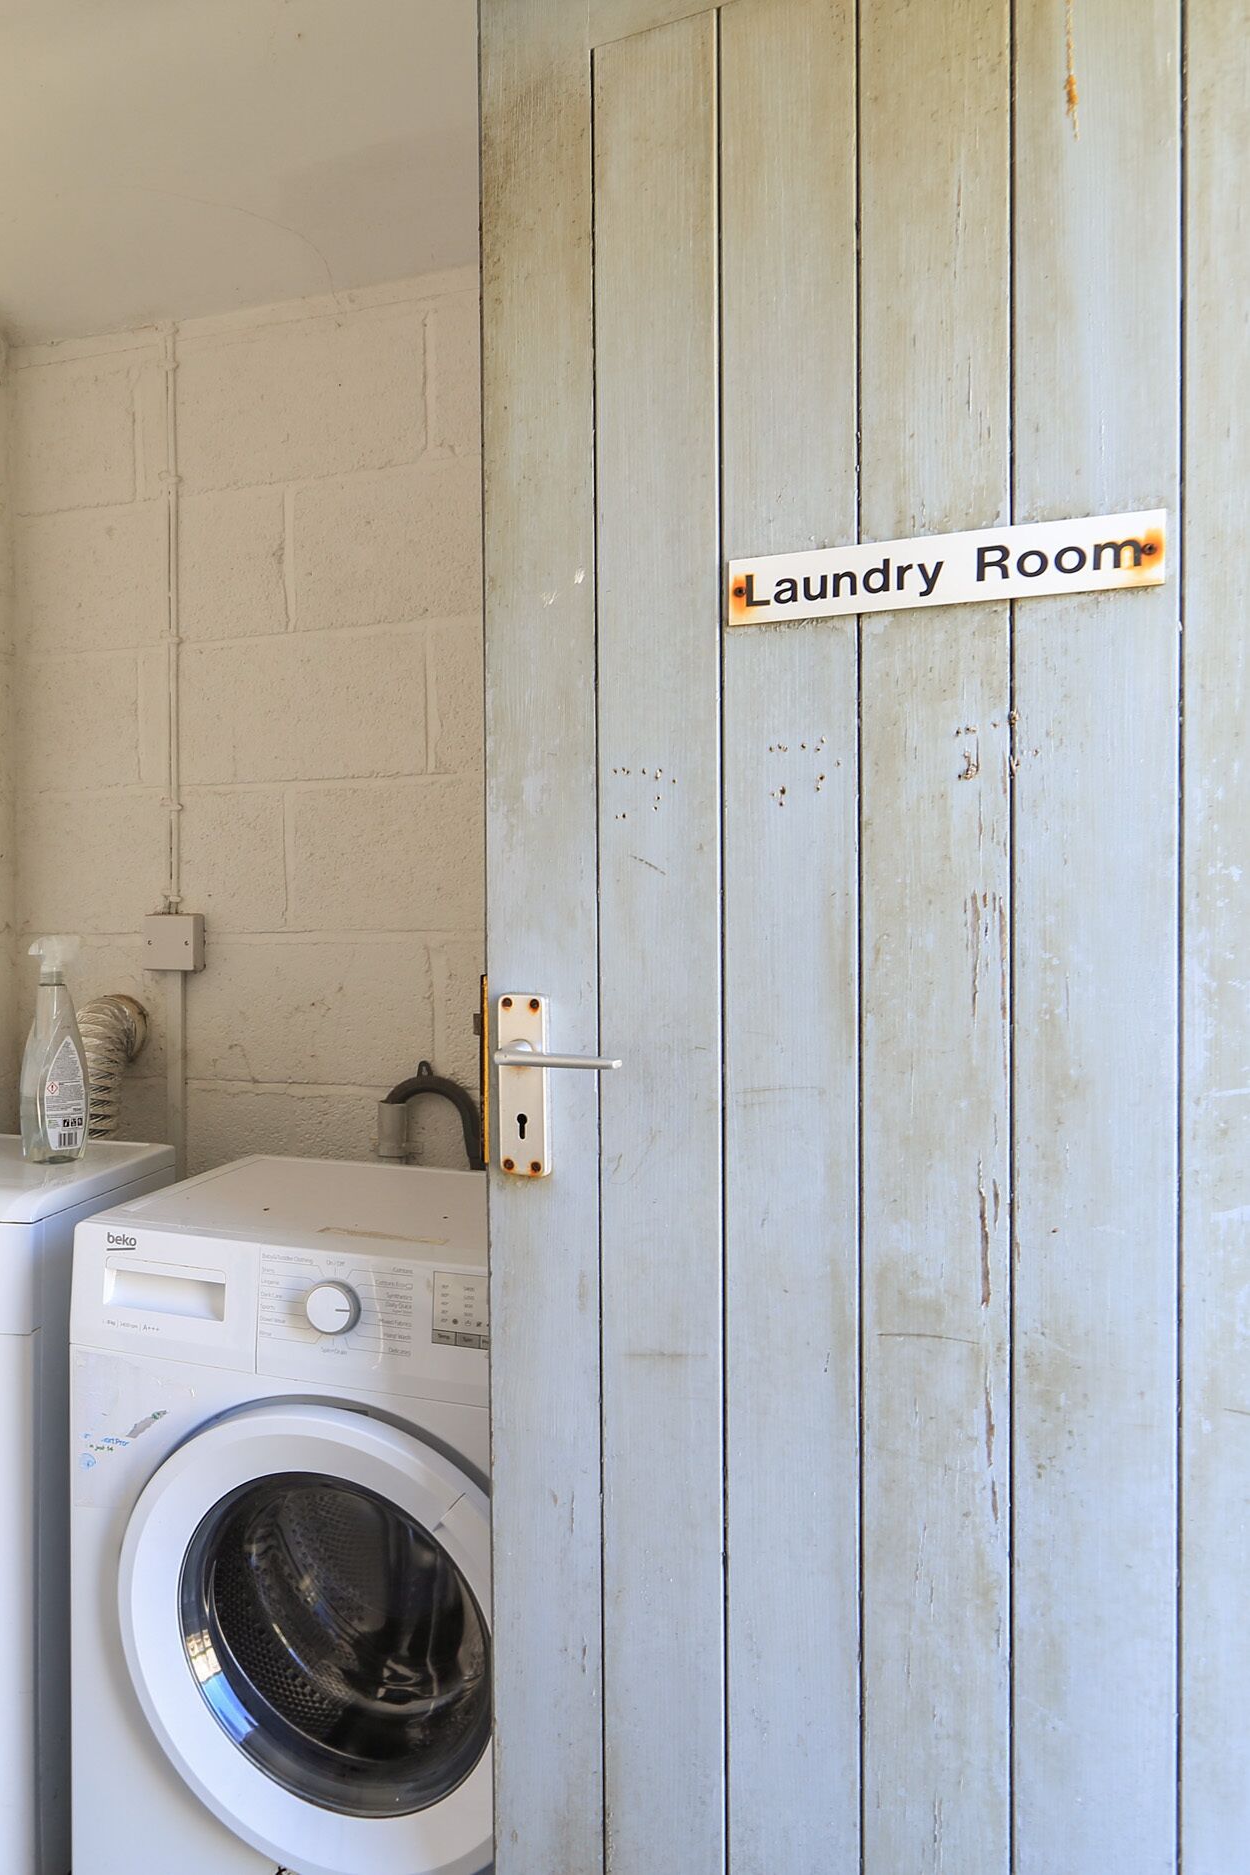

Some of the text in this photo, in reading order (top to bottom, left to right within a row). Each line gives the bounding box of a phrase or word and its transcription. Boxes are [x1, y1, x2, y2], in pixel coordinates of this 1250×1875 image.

[744, 538, 1144, 607] Laundry Room
[107, 1231, 138, 1247] beko
